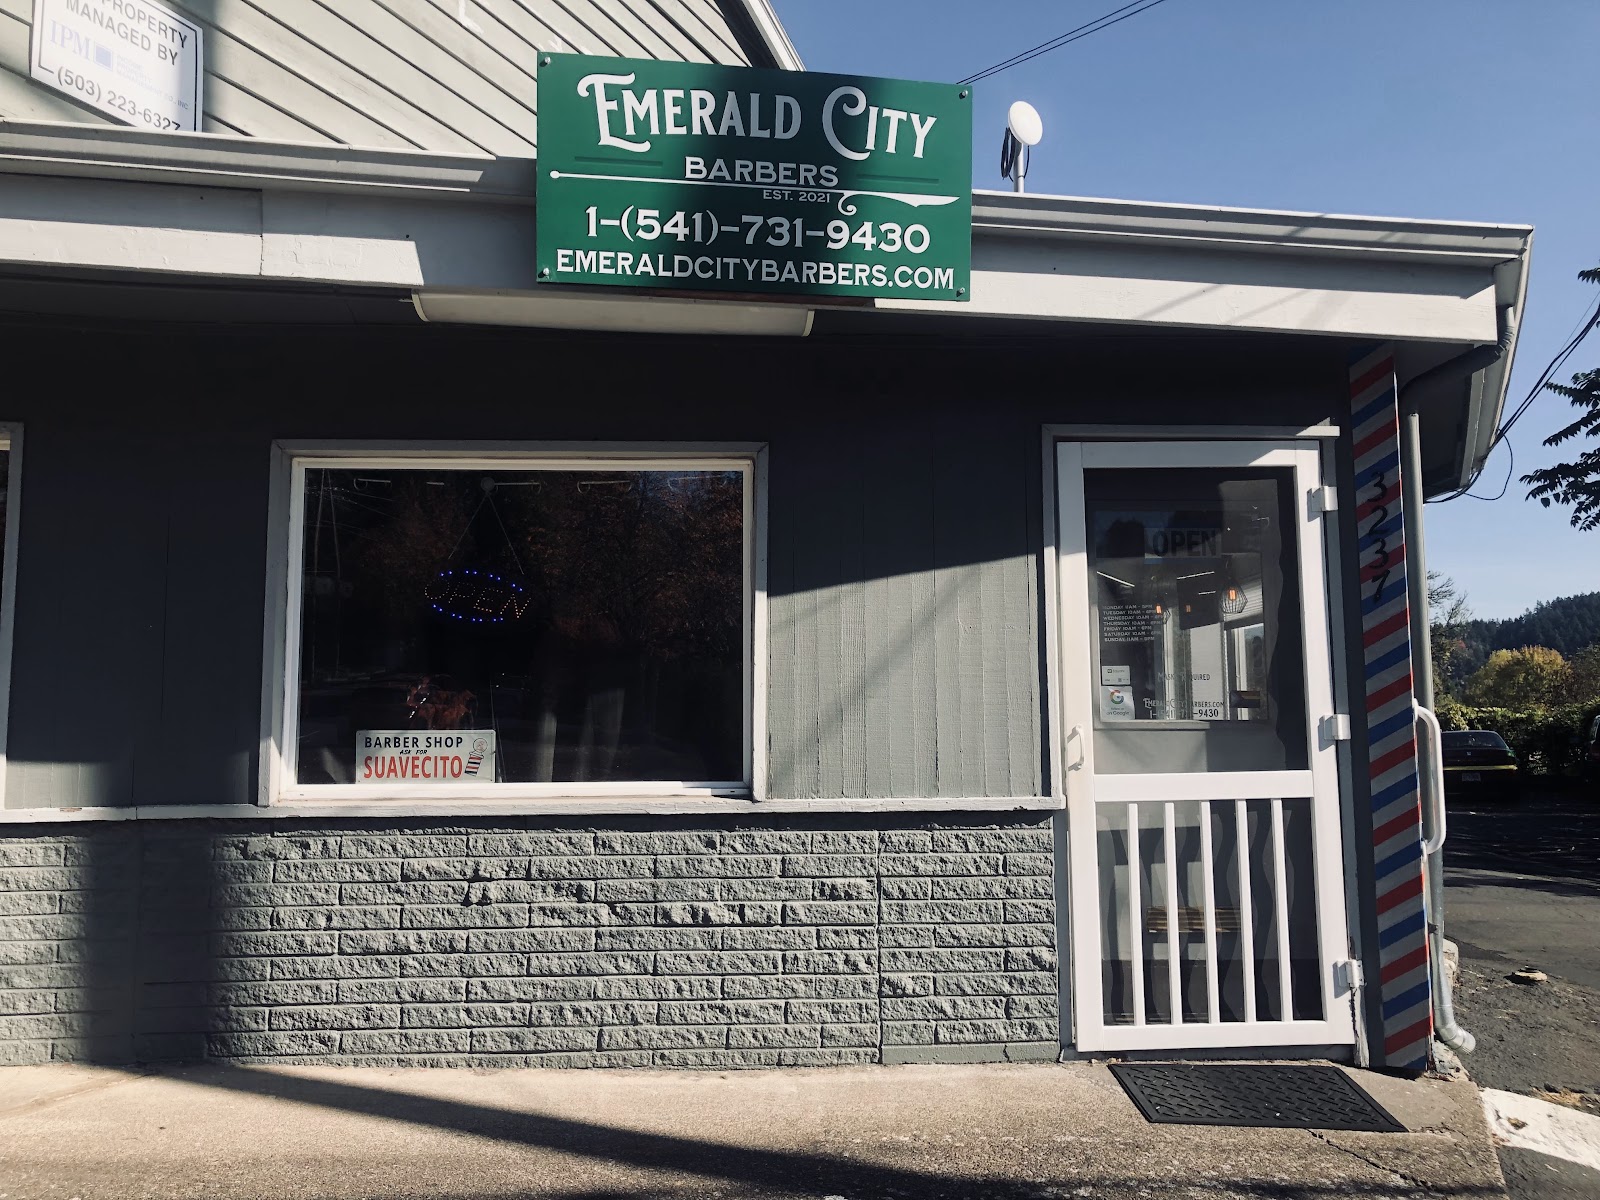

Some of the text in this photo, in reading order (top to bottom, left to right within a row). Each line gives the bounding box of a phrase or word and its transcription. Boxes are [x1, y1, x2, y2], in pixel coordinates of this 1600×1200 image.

[50, 19, 91, 60] IPM
[66, 0, 178, 65] MANAGED BY
[57, 66, 101, 102] (503)
[107, 90, 181, 130] 223-6327
[577, 72, 938, 161] EMERALD CITY
[684, 156, 839, 187] BARBERS
[763, 189, 831, 203] EST. 2021
[585, 204, 931, 254] 1-(541)-731-9430
[556, 248, 955, 291] EMERALDCITYBARBERS.COM
[1152, 530, 1217, 557] OPEN
[424, 578, 532, 619] OPEN
[364, 736, 463, 748] BARBER SHOP
[363, 755, 463, 779] SUAVECITO
